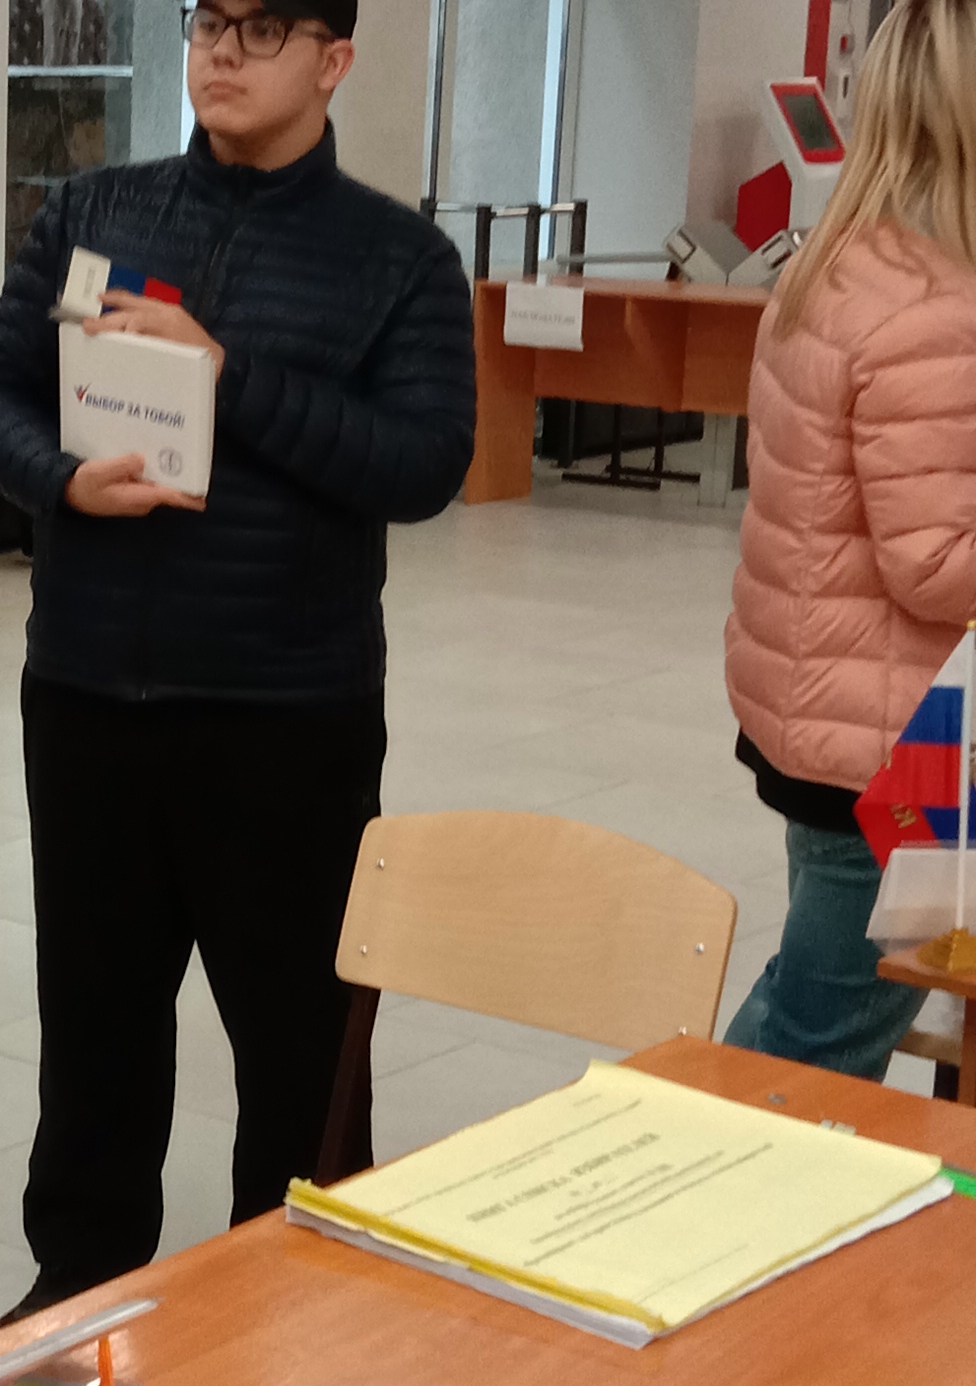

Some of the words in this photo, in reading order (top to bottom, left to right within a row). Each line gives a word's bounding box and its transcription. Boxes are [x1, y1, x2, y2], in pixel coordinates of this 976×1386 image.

[84, 393, 125, 413] ВЫБОР
[127, 402, 141, 419] ЗА
[143, 405, 186, 429] ТОБОЙ!
